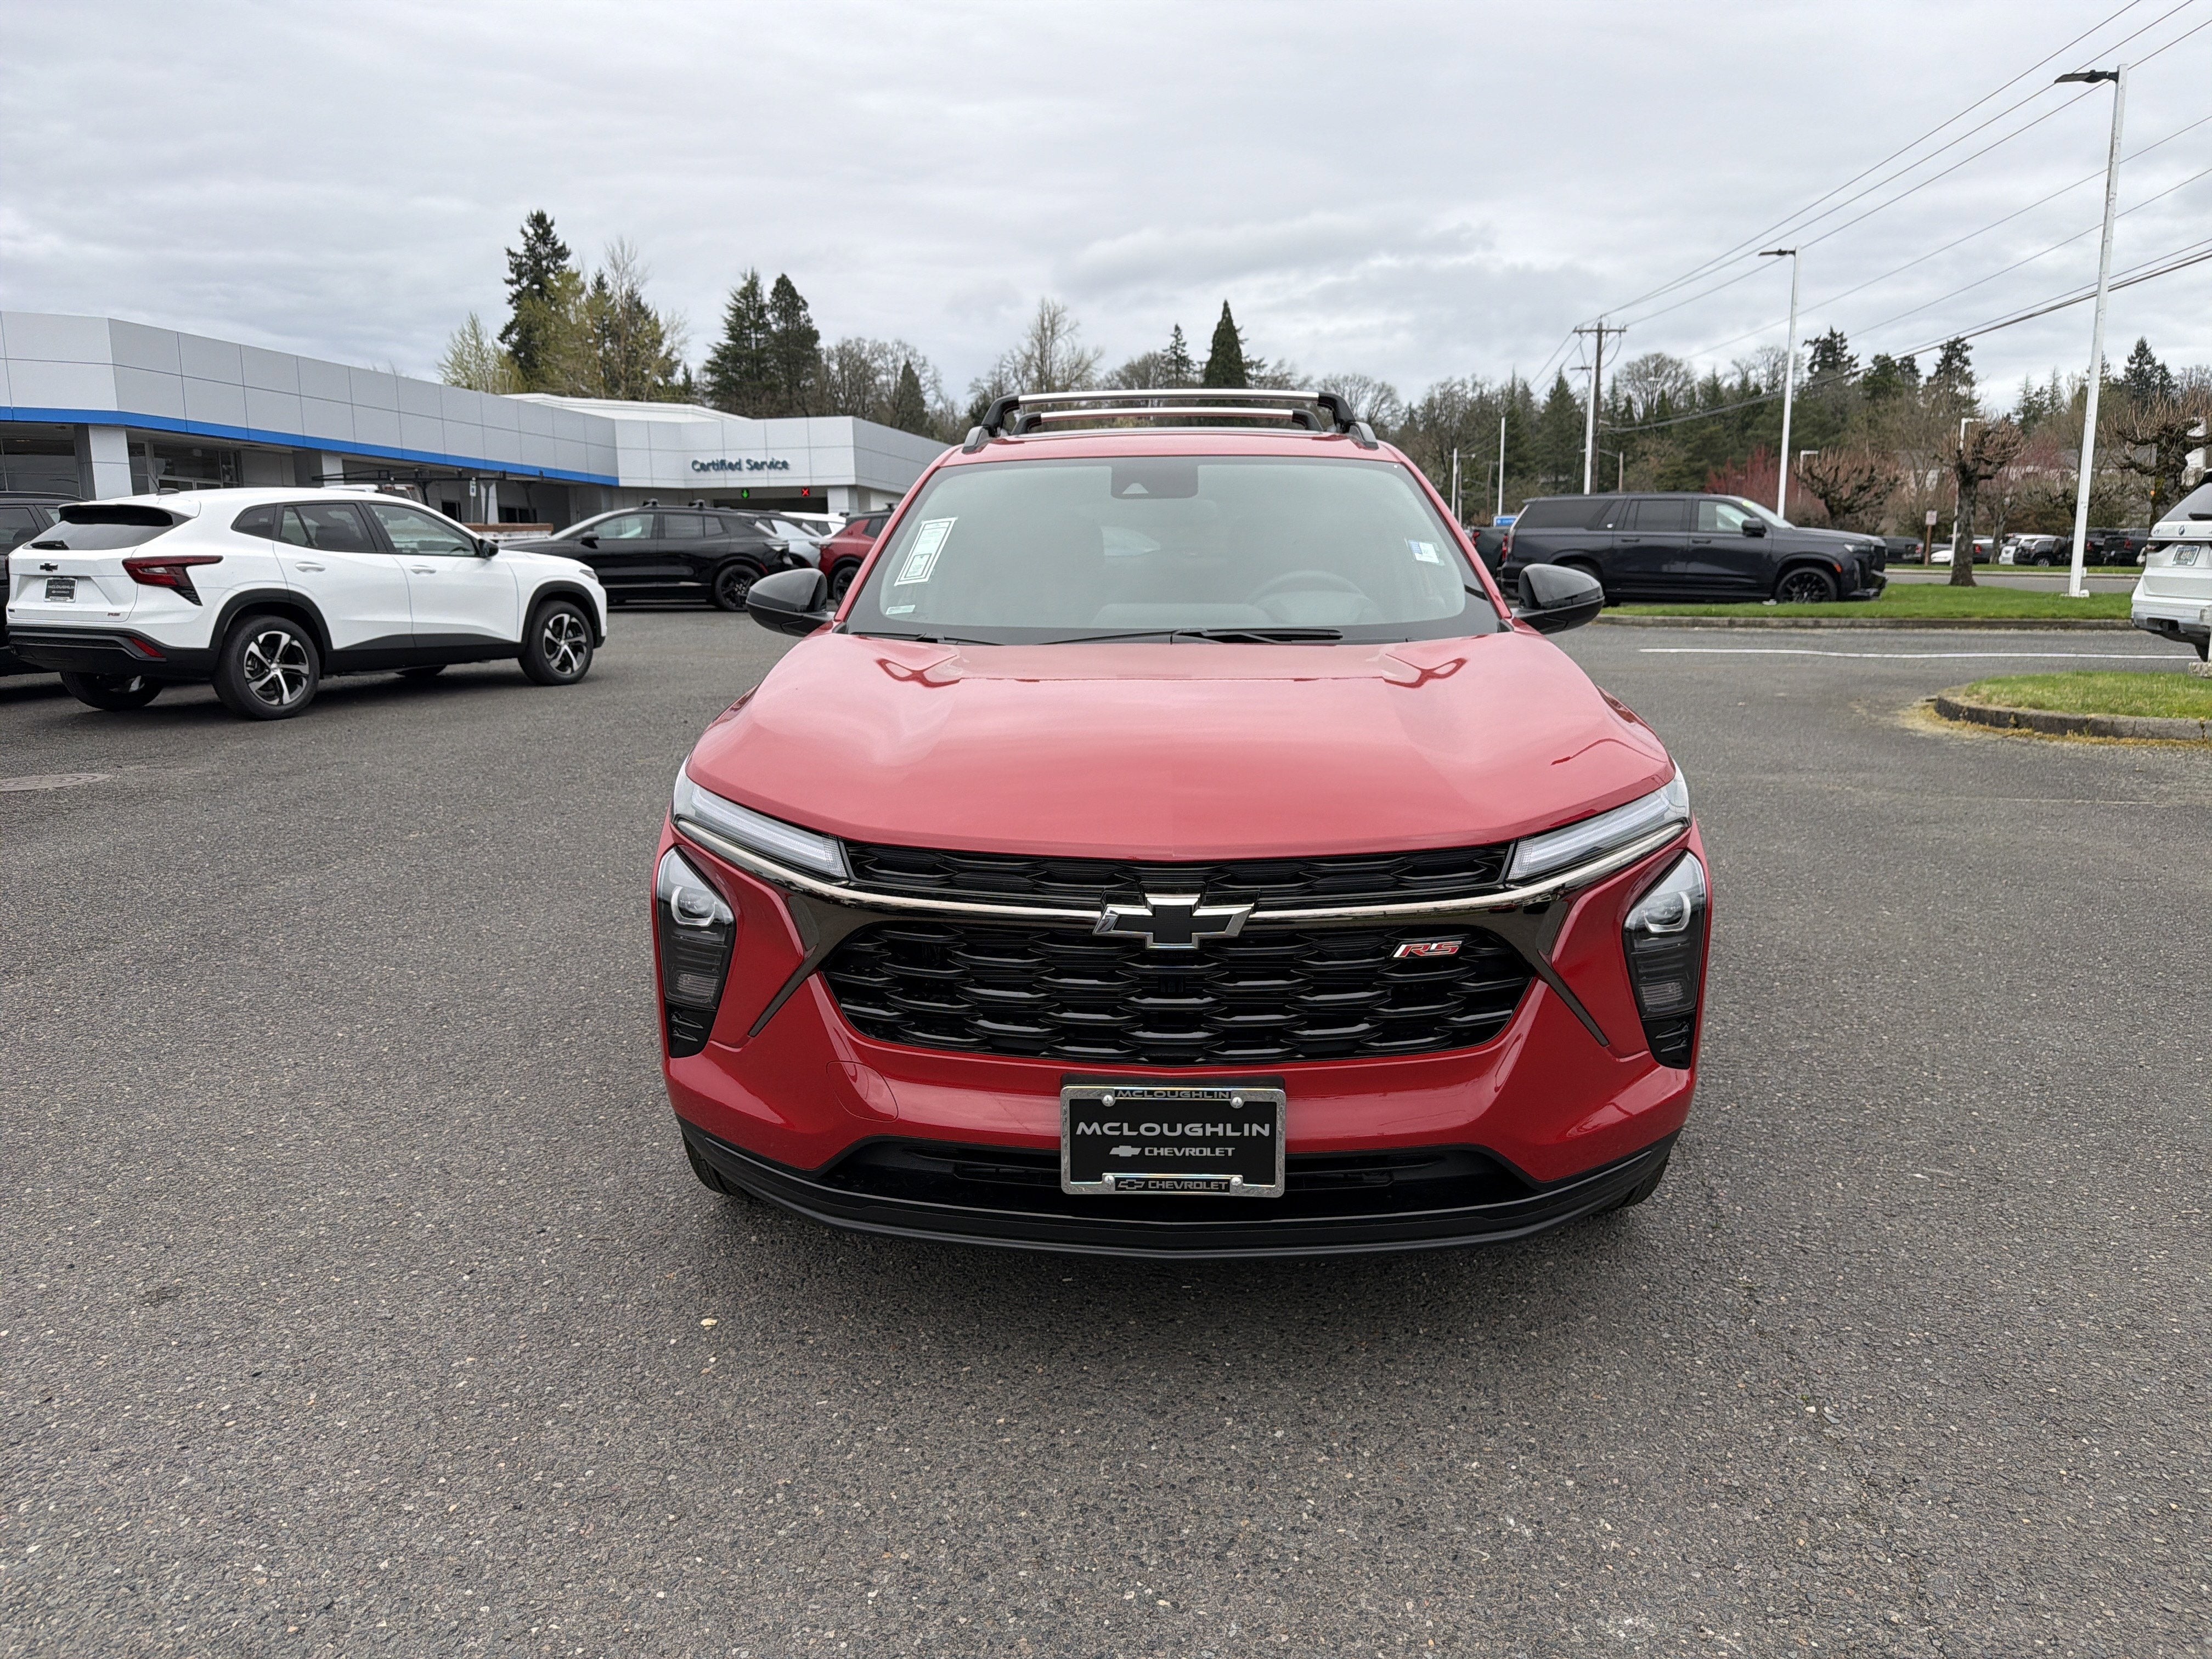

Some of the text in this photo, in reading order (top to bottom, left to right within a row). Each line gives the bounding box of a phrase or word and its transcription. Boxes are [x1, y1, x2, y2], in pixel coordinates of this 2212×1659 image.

[691, 458, 790, 472] Certified Service
[1393, 940, 1463, 958] RS
[1116, 1090, 1229, 1099] MCLOUGHLIN
[1076, 1122, 1270, 1137] MCLOUGHLIN
[1144, 1147, 1235, 1156] CHEVROLET
[1148, 1181, 1228, 1190] CHEVROLET
